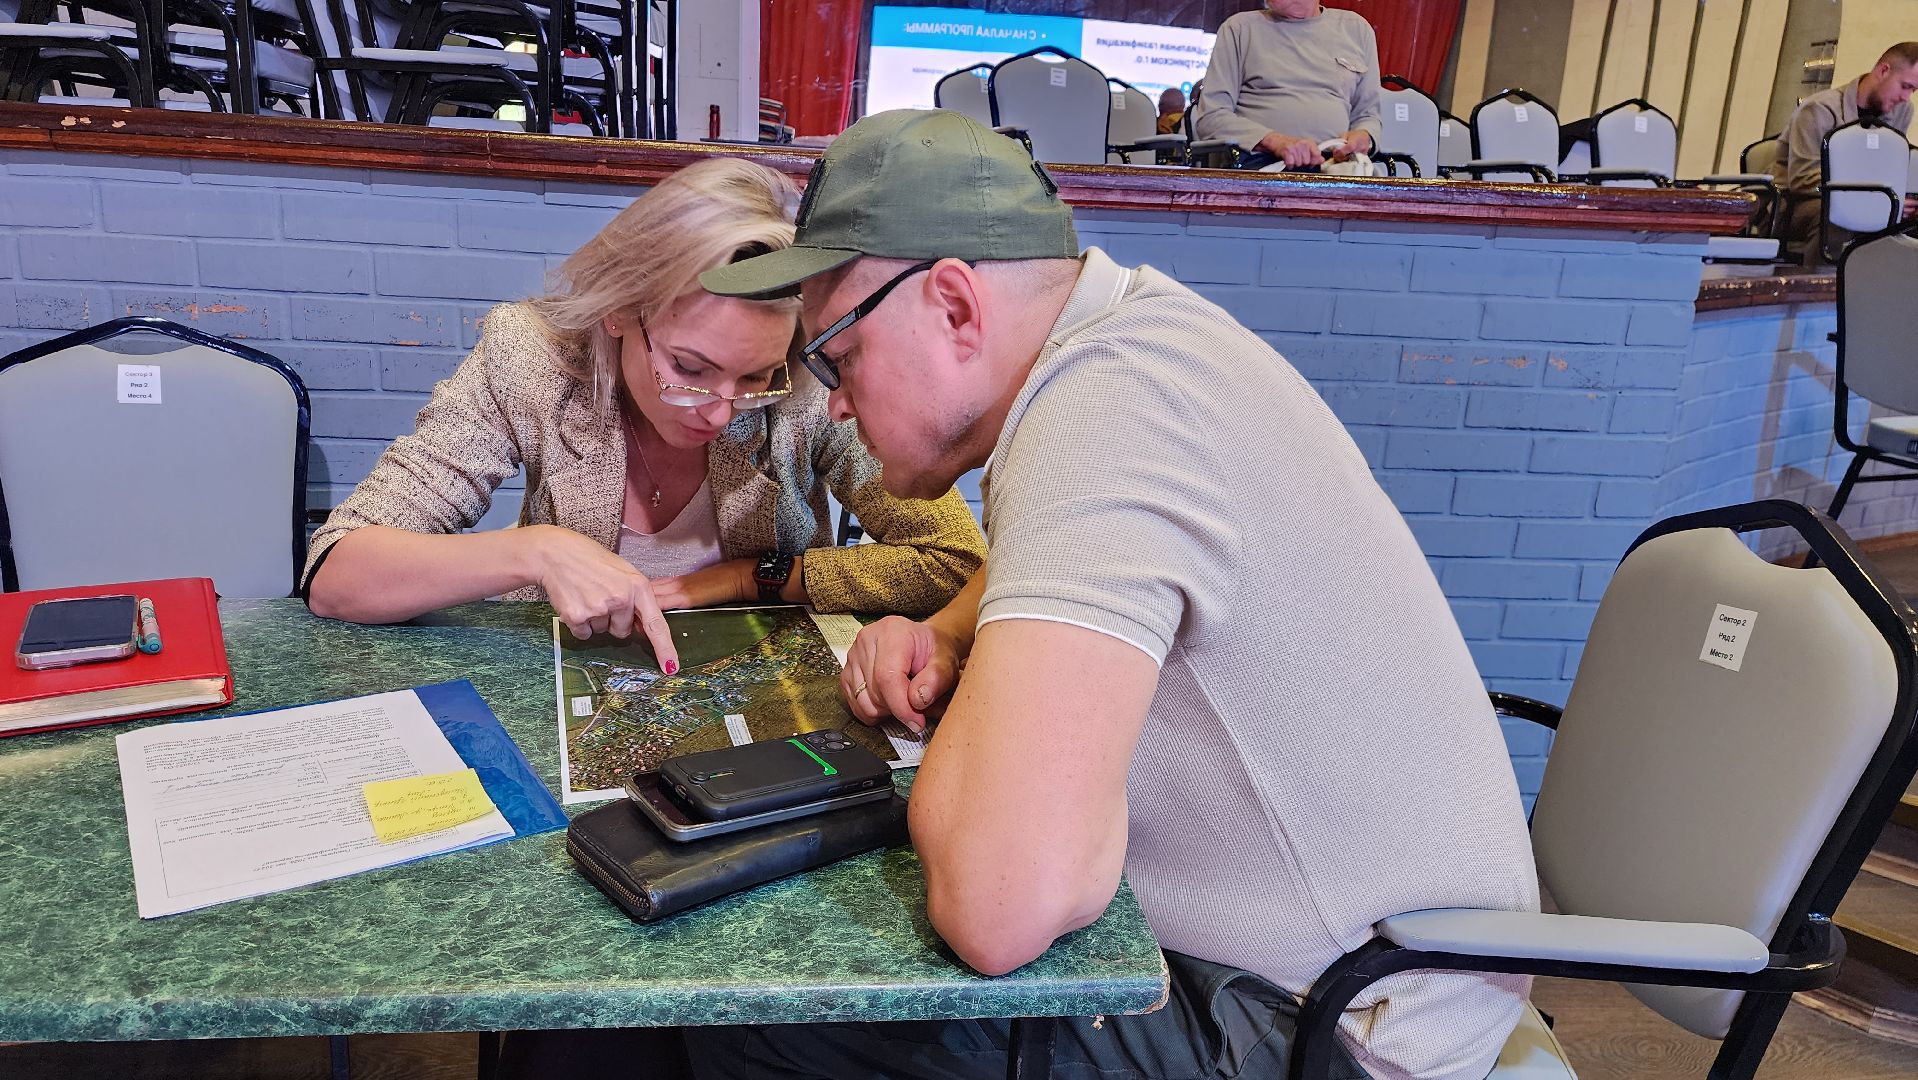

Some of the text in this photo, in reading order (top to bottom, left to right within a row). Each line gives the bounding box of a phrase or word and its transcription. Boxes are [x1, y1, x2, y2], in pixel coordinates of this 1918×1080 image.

[1719, 614, 1741, 626] Сектор
[1719, 632, 1730, 642] Ряд
[1710, 648, 1728, 659] Место
